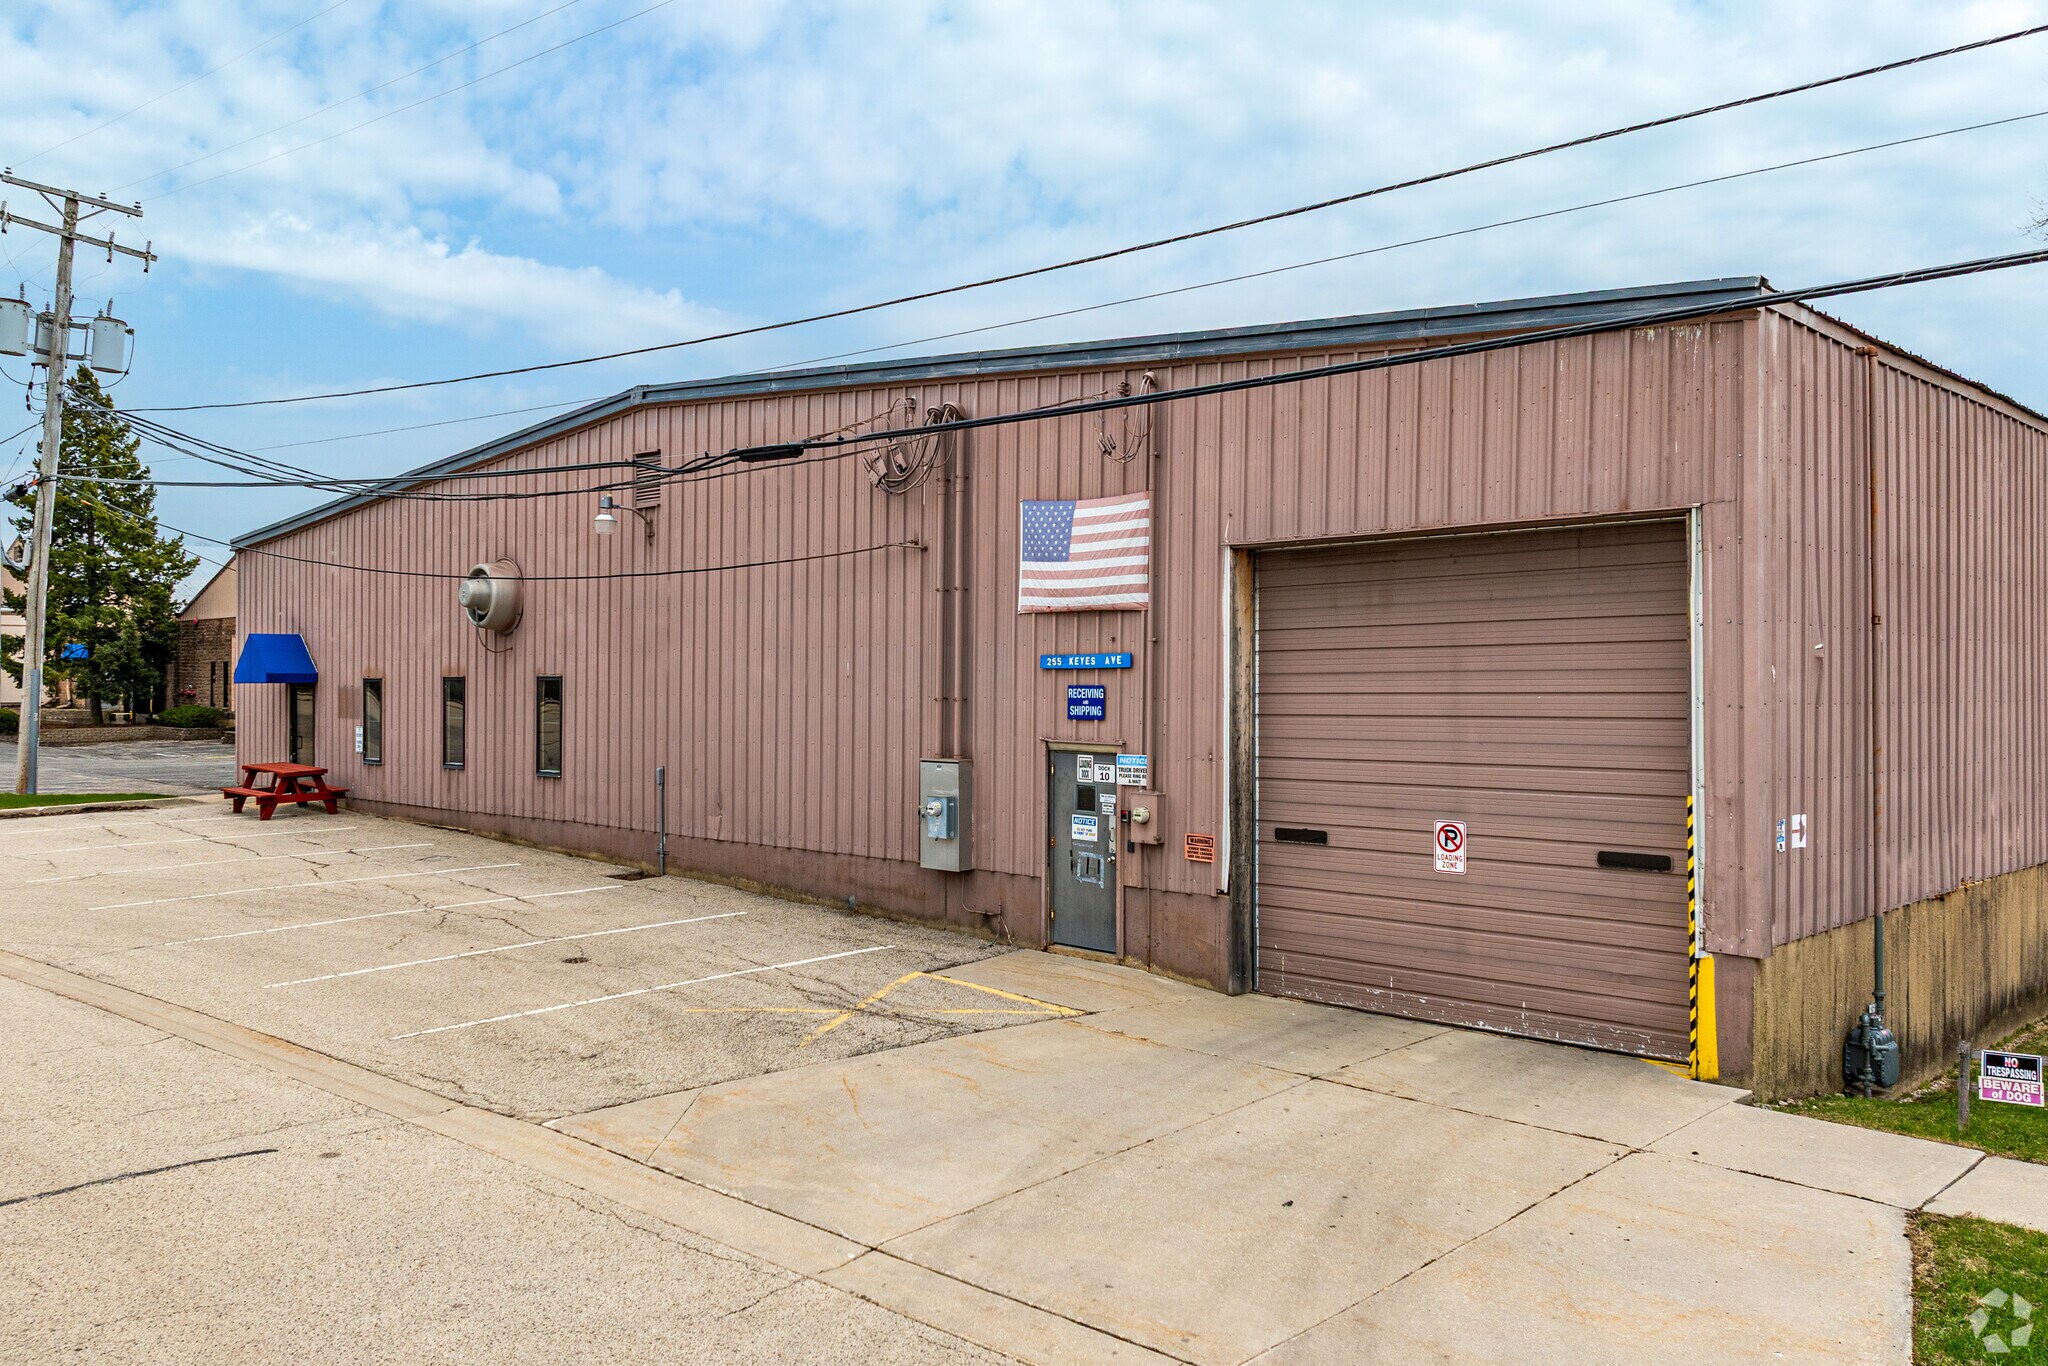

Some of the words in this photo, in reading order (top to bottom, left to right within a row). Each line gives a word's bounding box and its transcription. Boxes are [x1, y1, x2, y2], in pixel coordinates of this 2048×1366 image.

[1047, 657, 1062, 666] 255
[1068, 656, 1096, 666] KEYES
[1104, 655, 1122, 665] AVE
[1068, 688, 1104, 699] RECEIVING
[1069, 705, 1102, 716] SHIPPING
[1079, 759, 1092, 768] LOADING
[1081, 769, 1090, 778] DOCK
[1099, 772, 1110, 781] 10
[1073, 817, 1096, 826] NOTICE
[1437, 854, 1463, 862] LOADING
[2004, 1057, 2019, 1068] NO
[1986, 1065, 2037, 1080] TRESPASSING
[1983, 1079, 2039, 1094] BEWARE
[1991, 1090, 2003, 1099] of
[2006, 1091, 2031, 1103] DOG
